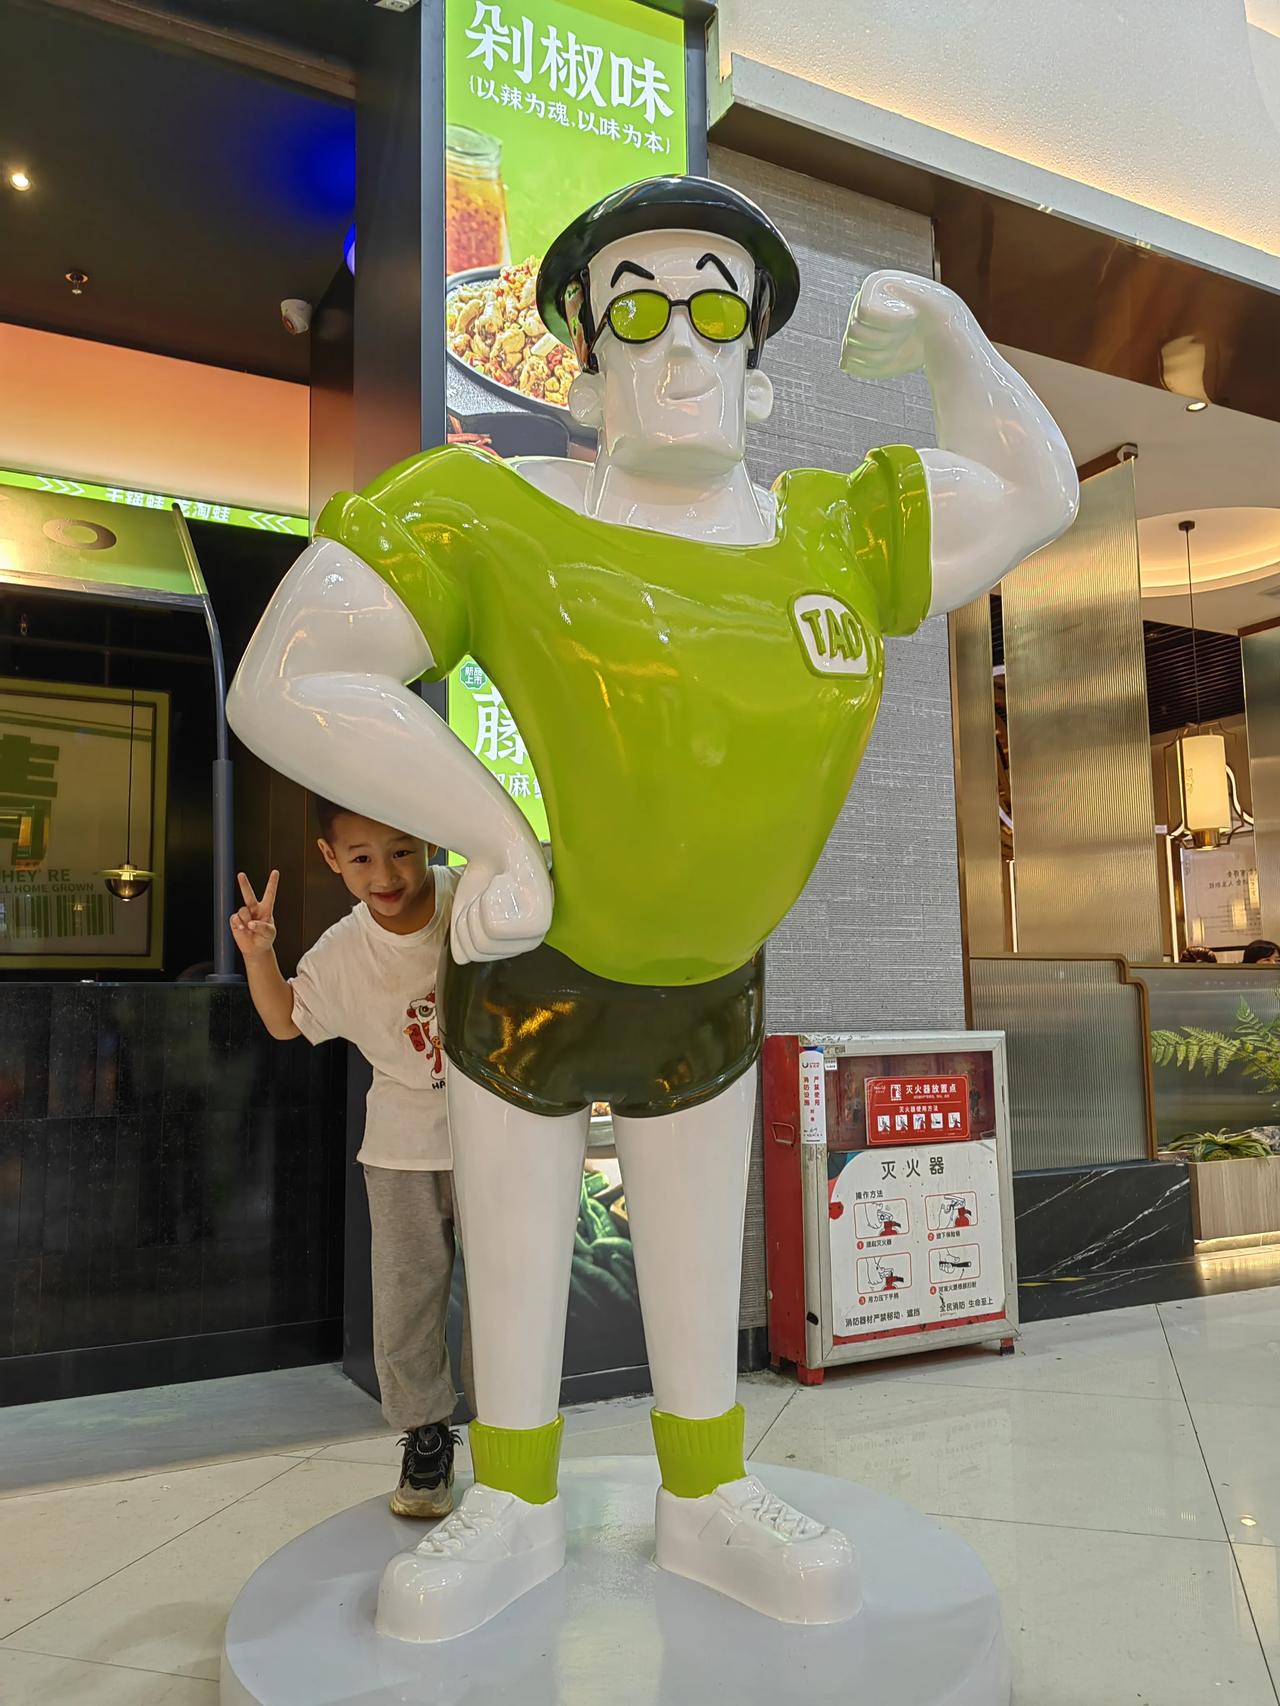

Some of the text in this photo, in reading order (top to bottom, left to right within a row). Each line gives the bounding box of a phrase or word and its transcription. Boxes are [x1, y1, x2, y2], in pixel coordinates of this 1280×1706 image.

[465, 1, 674, 124] 剁椒味
[800, 608, 863, 661] TAO
[15, 884, 48, 894] HOME
[52, 883, 94, 893] GROWN
[906, 1084, 957, 1094] 灭火器放置点
[881, 1156, 945, 1180] 灭火器
[855, 1189, 883, 1200] 操作方法
[968, 1297, 994, 1309] 生命至上
